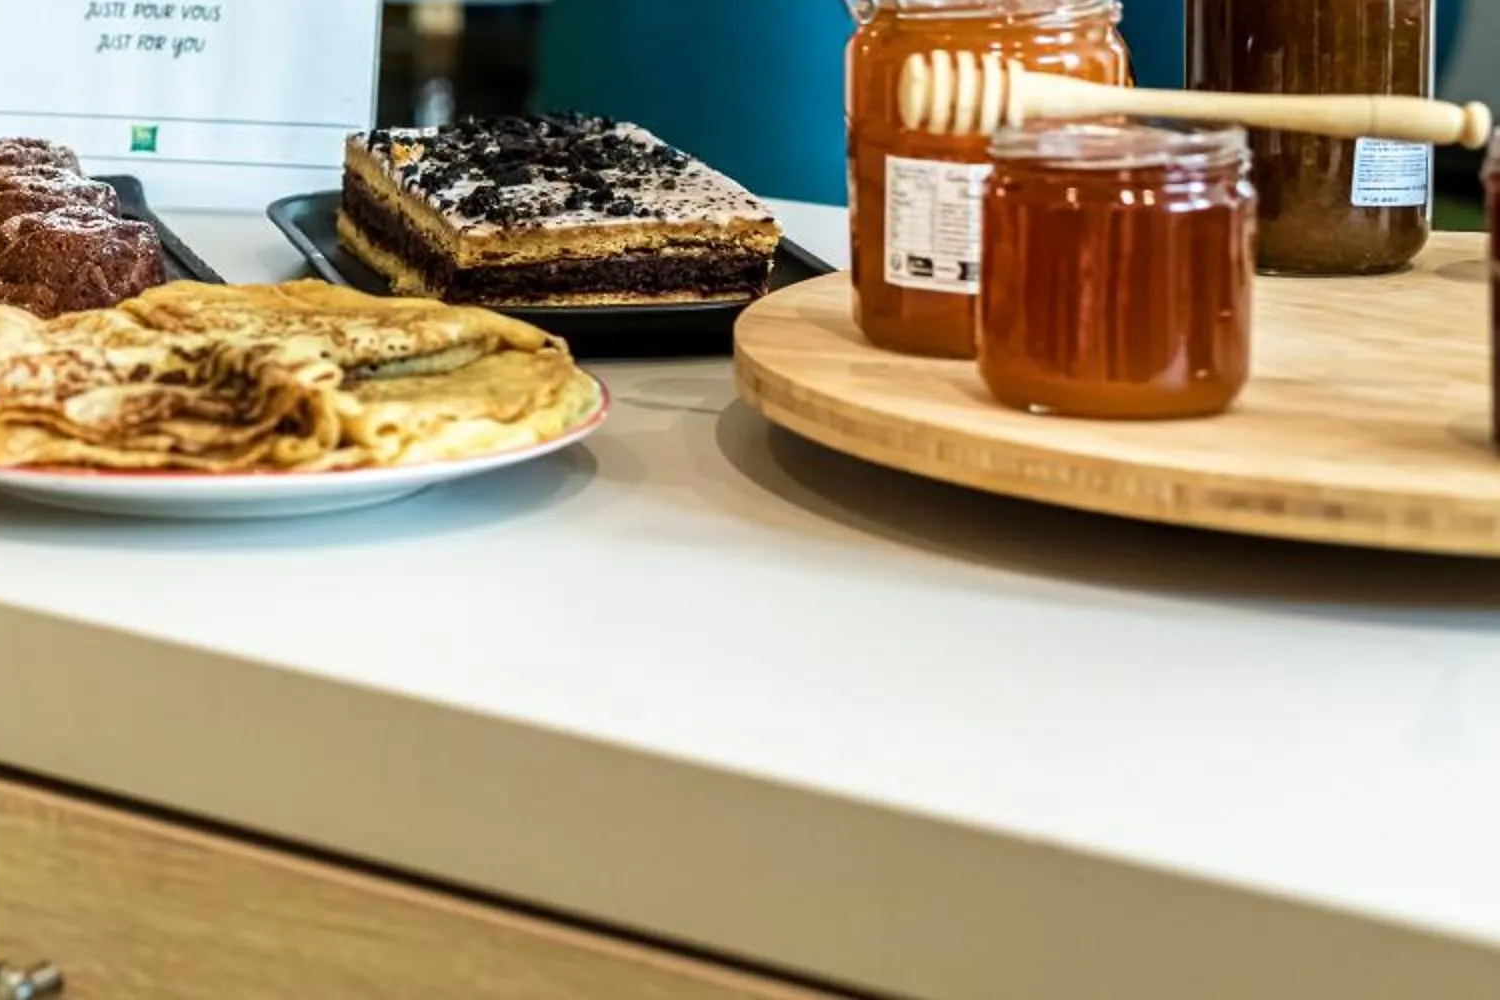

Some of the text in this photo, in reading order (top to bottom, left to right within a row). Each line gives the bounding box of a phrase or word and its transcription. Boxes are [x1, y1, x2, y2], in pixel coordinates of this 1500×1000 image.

[83, 0, 222, 22] JUSTE POUR VOUS
[95, 33, 133, 54] JUST
[136, 34, 168, 52] FOR
